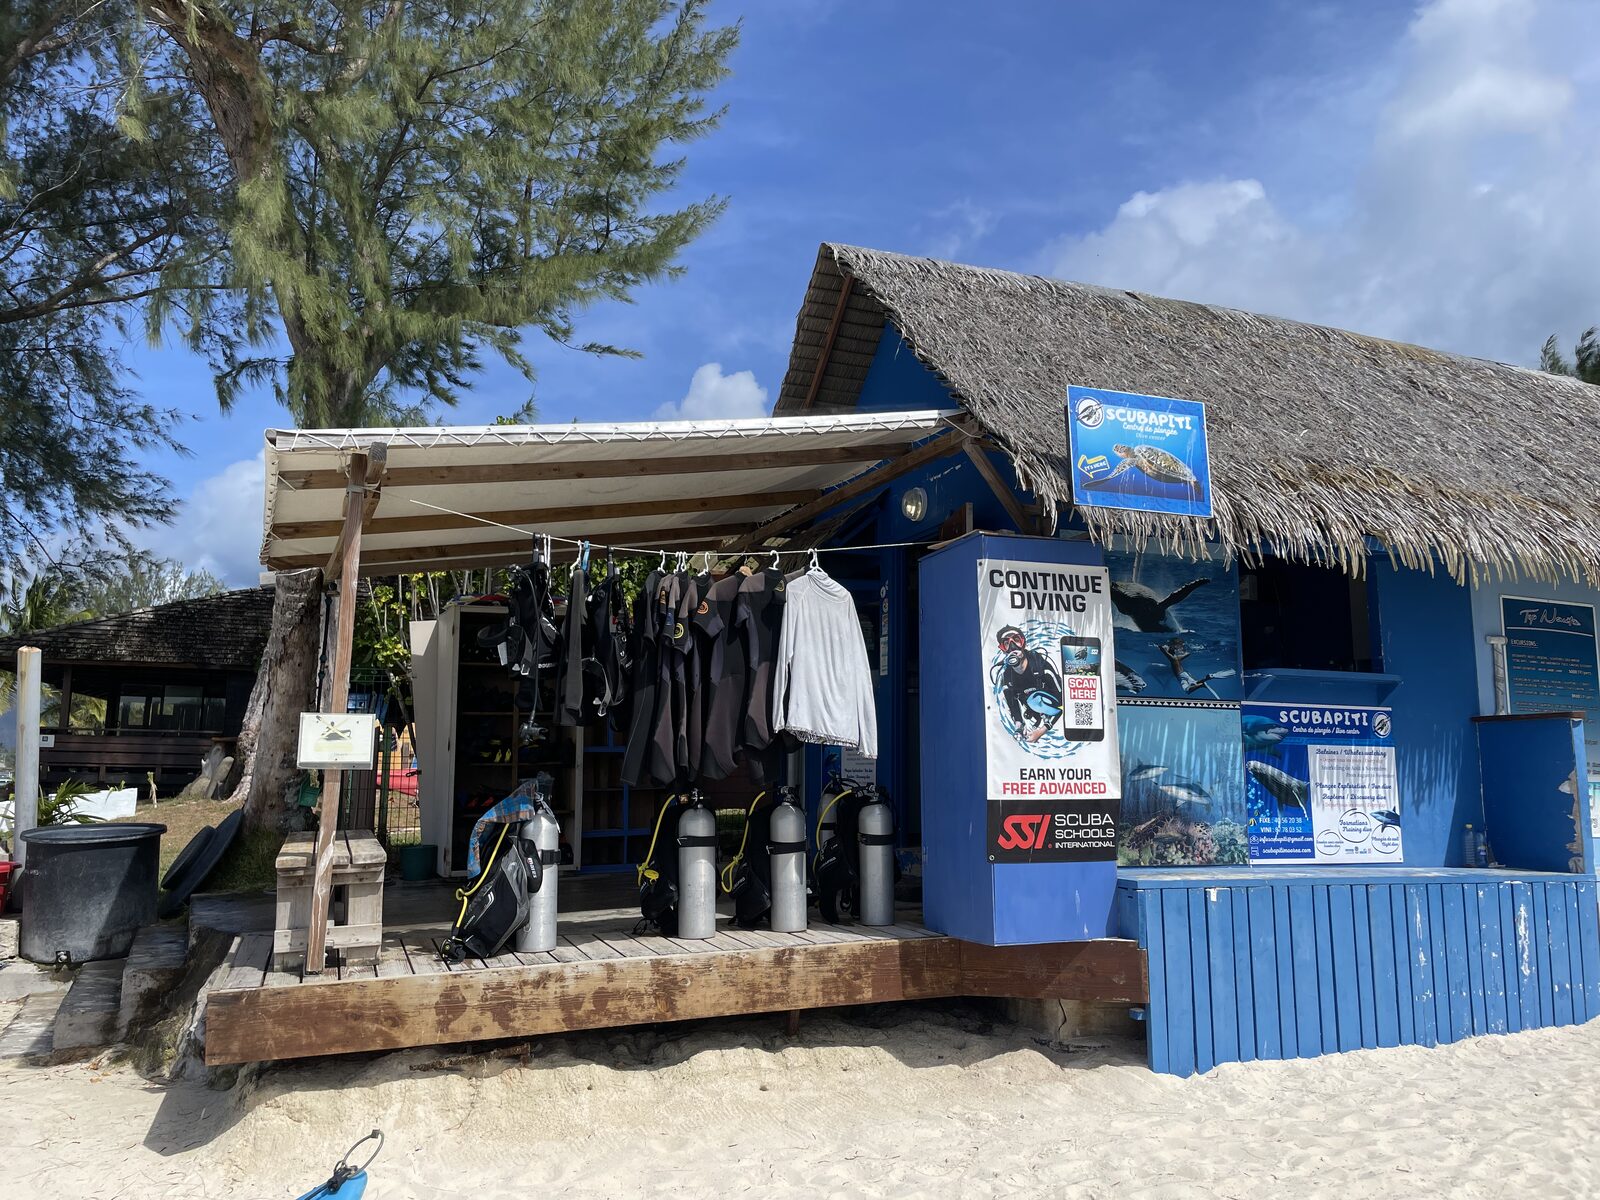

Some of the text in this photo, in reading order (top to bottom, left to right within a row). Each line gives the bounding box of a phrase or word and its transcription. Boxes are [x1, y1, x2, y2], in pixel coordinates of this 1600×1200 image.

[1106, 408, 1192, 430] SCUBAPITI
[989, 569, 1102, 593] CONTINUE
[1010, 591, 1086, 612] DIVING
[1068, 678, 1096, 688] SCAN
[1070, 689, 1096, 700] HERE
[1280, 710, 1368, 726] SCUBAPITI
[1019, 768, 1092, 780] EARN YOUR
[1002, 782, 1107, 795] FREE ADVANCED
[1054, 813, 1115, 826] SCUBA
[997, 814, 1051, 849] SSI
[1055, 828, 1115, 839] SCHOOLS
[1055, 840, 1115, 849] INTERNATIONAL
[527, 857, 537, 878] mares
